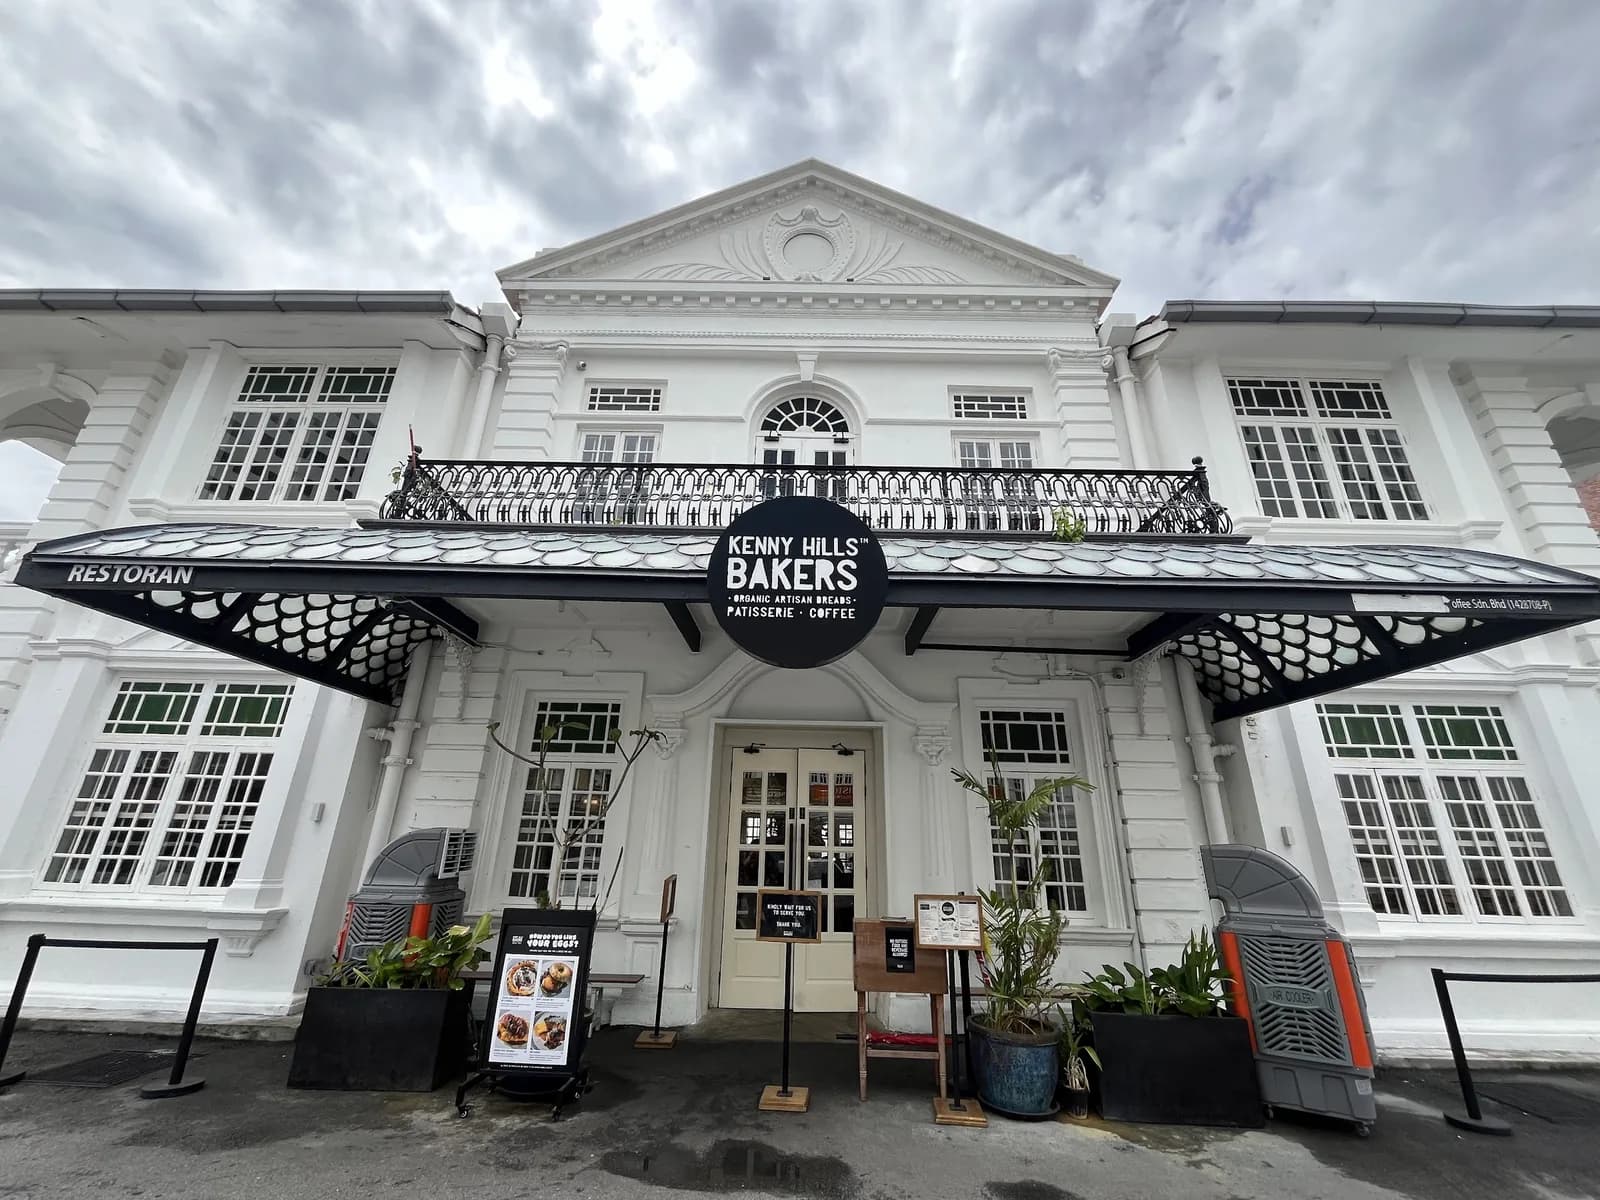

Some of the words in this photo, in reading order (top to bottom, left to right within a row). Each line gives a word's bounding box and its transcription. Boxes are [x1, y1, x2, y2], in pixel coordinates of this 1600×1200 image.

[728, 535, 794, 555] KENNY
[67, 564, 194, 584] RESTORAN
[726, 557, 858, 591] BAKERS
[775, 595, 813, 604] ARTISAN
[1451, 598, 1471, 609] offee
[1491, 598, 1507, 609] Bhd
[809, 607, 856, 619] COFFEE
[527, 939, 551, 948] YOUR
[552, 940, 579, 948] EGGS?
